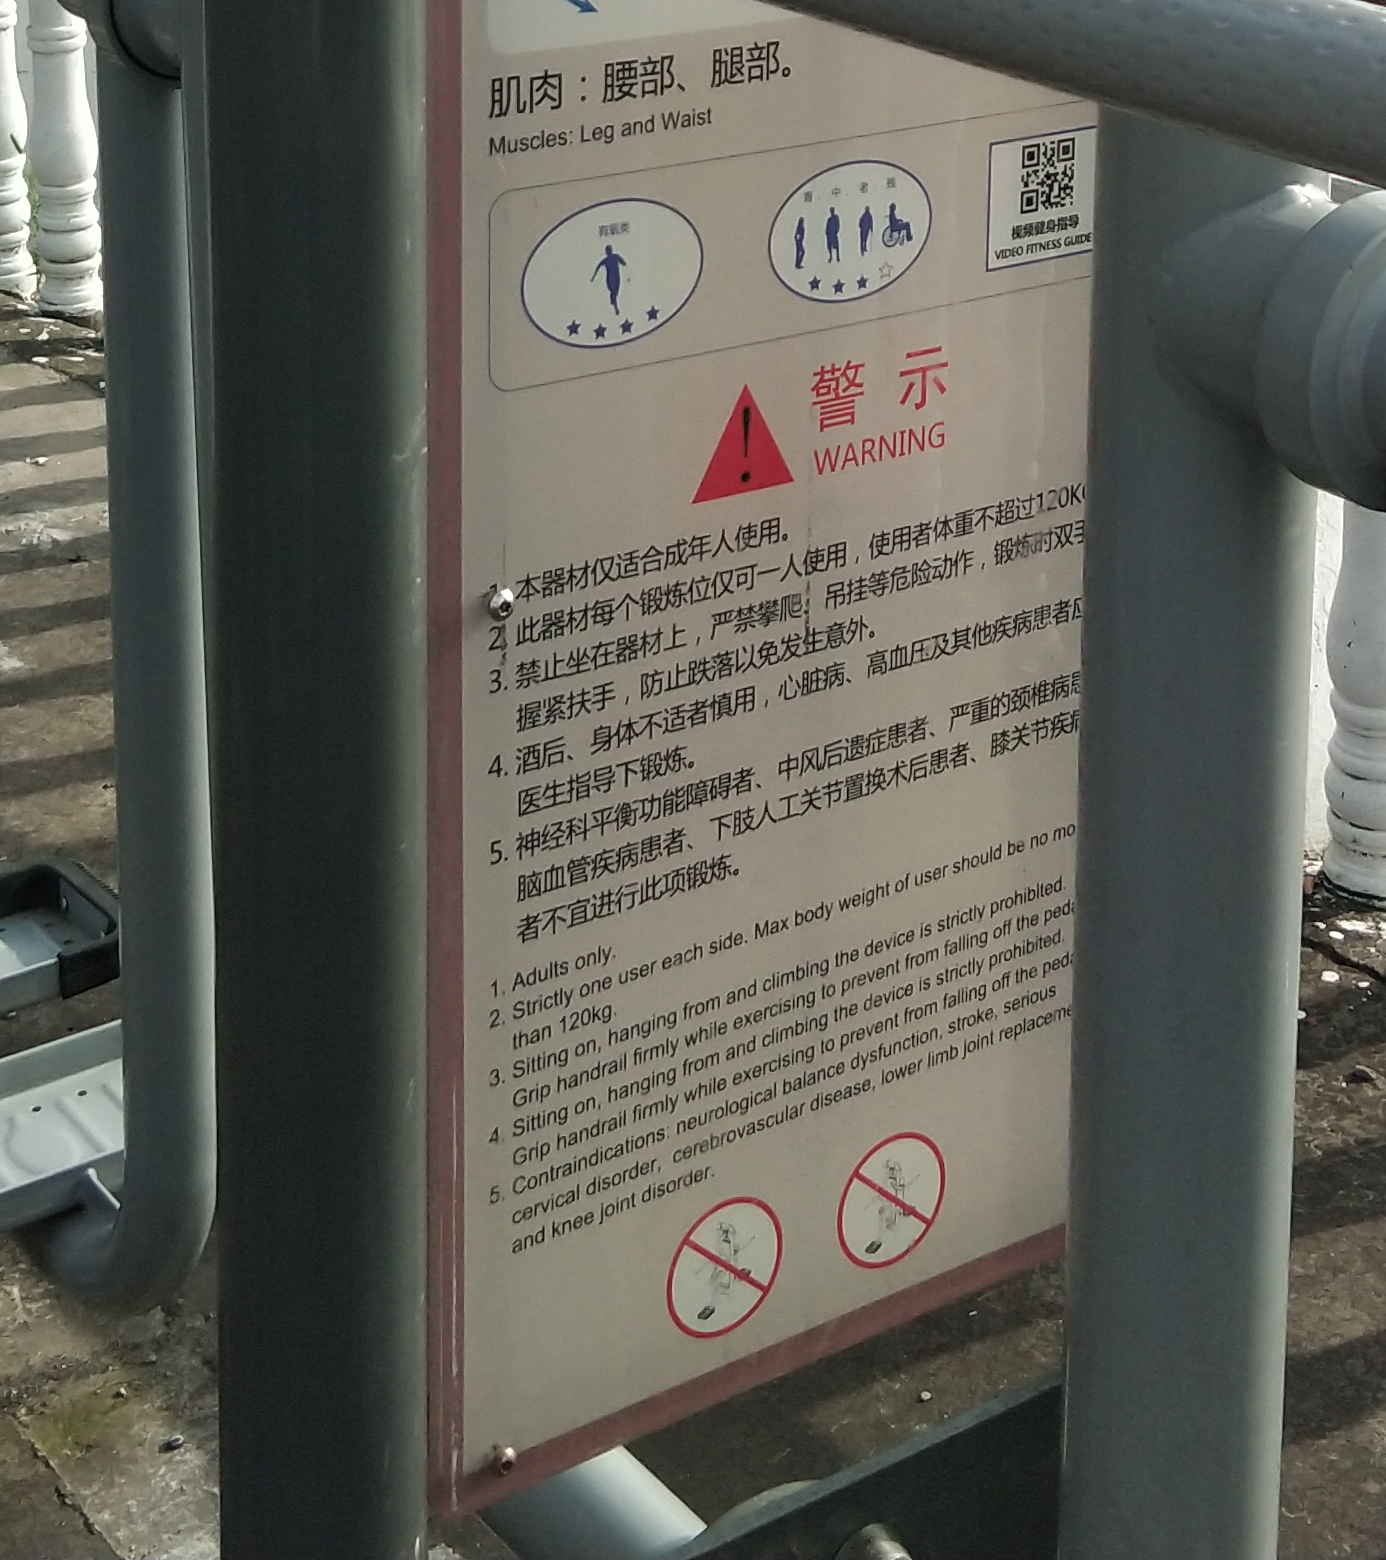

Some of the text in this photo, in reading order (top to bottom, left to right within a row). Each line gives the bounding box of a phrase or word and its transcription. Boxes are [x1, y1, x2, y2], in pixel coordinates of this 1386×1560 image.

[488, 107, 713, 156] Muscles: Leg and Waist
[994, 232, 1092, 260] VIDEO FITNESS GUIDE
[814, 422, 947, 477] WARNING
[515, 516, 789, 602] 本器材仅适合成年人使用。
[516, 615, 876, 733] 握紧扶手，防止跌落以免发生意外。
[517, 744, 696, 818] 医生指导下锻炼。
[489, 822, 1076, 1029] 2. Strictly one user each side. Max body weight of user should be no mo
[516, 852, 740, 944] 者不宜进行此项锻炼。
[489, 874, 1066, 1087] 3. Sitting on, hanging from and climbing the device is strictly prohibited.
[490, 945, 616, 998] 1. Adults only.
[512, 1082, 554, 1108] Grip
[554, 1051, 628, 1094] handrail
[633, 1036, 679, 1066] firmly
[684, 1020, 727, 1048] while
[733, 989, 817, 1030] exercising
[821, 983, 838, 1000] to
[838, 958, 900, 997] prevent
[905, 947, 939, 971] from
[941, 930, 988, 957] falling
[993, 917, 1012, 939] off
[1015, 913, 1039, 933] the
[512, 1004, 616, 1050] than 120kg.
[512, 1105, 568, 1137] Sitting
[574, 1096, 602, 1115] on,
[607, 1067, 676, 1104] hanging
[682, 1052, 719, 1078] from
[725, 1034, 759, 1061] and
[759, 1012, 831, 1049] climbing
[831, 1003, 861, 1022] the
[861, 981, 916, 1011] device
[916, 976, 931, 993] is
[935, 956, 985, 986] strictly
[988, 927, 1064, 972] prohibited.
[513, 1140, 550, 1166] Grip
[556, 1104, 629, 1150] handrail
[629, 1093, 679, 1123] firmly
[683, 1076, 727, 1104] while
[732, 1045, 817, 1086] exercising
[817, 1037, 838, 1056] to
[838, 1012, 898, 1052] prevent
[901, 1001, 937, 1025] from
[940, 983, 986, 1010] falling
[991, 970, 1011, 993] off
[1014, 966, 1037, 984] the
[489, 985, 1056, 1204] 5. Contraindications: neurological balance dysfunction, stroke, serious
[511, 995, 1073, 1224] cervical disorder, cerebrovascular disease, lower limb joint replaceme
[511, 1165, 714, 1254] and knee joint disorder.
